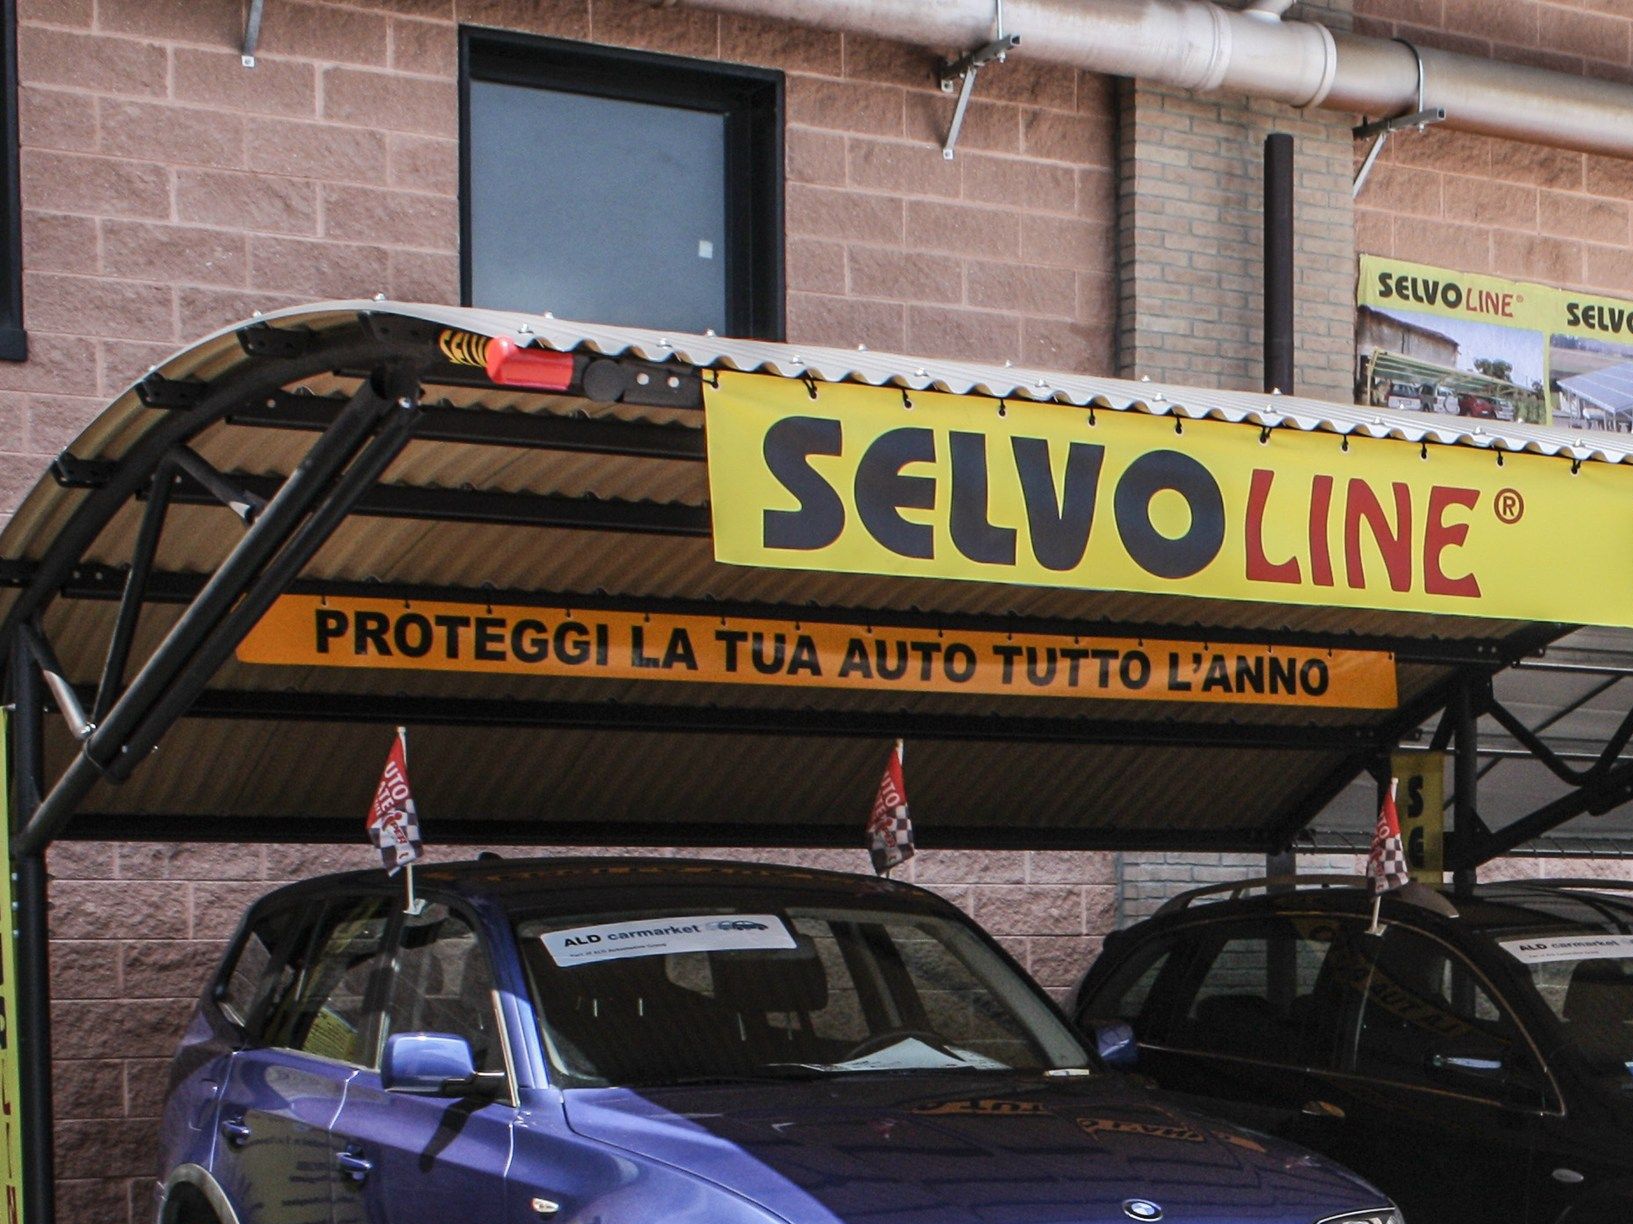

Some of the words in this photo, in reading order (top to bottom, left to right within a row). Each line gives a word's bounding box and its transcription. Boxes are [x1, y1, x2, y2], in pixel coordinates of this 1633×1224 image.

[315, 608, 609, 667] PROTEGGI
[631, 625, 699, 671] LA
[715, 630, 823, 676] TUA
[838, 637, 978, 682] AUTO
[993, 645, 1151, 691] TUTTO
[1168, 652, 1330, 697] L'ANNO
[384, 761, 409, 800] UTO
[564, 935, 602, 947] ALD
[607, 924, 700, 941] carmarket
